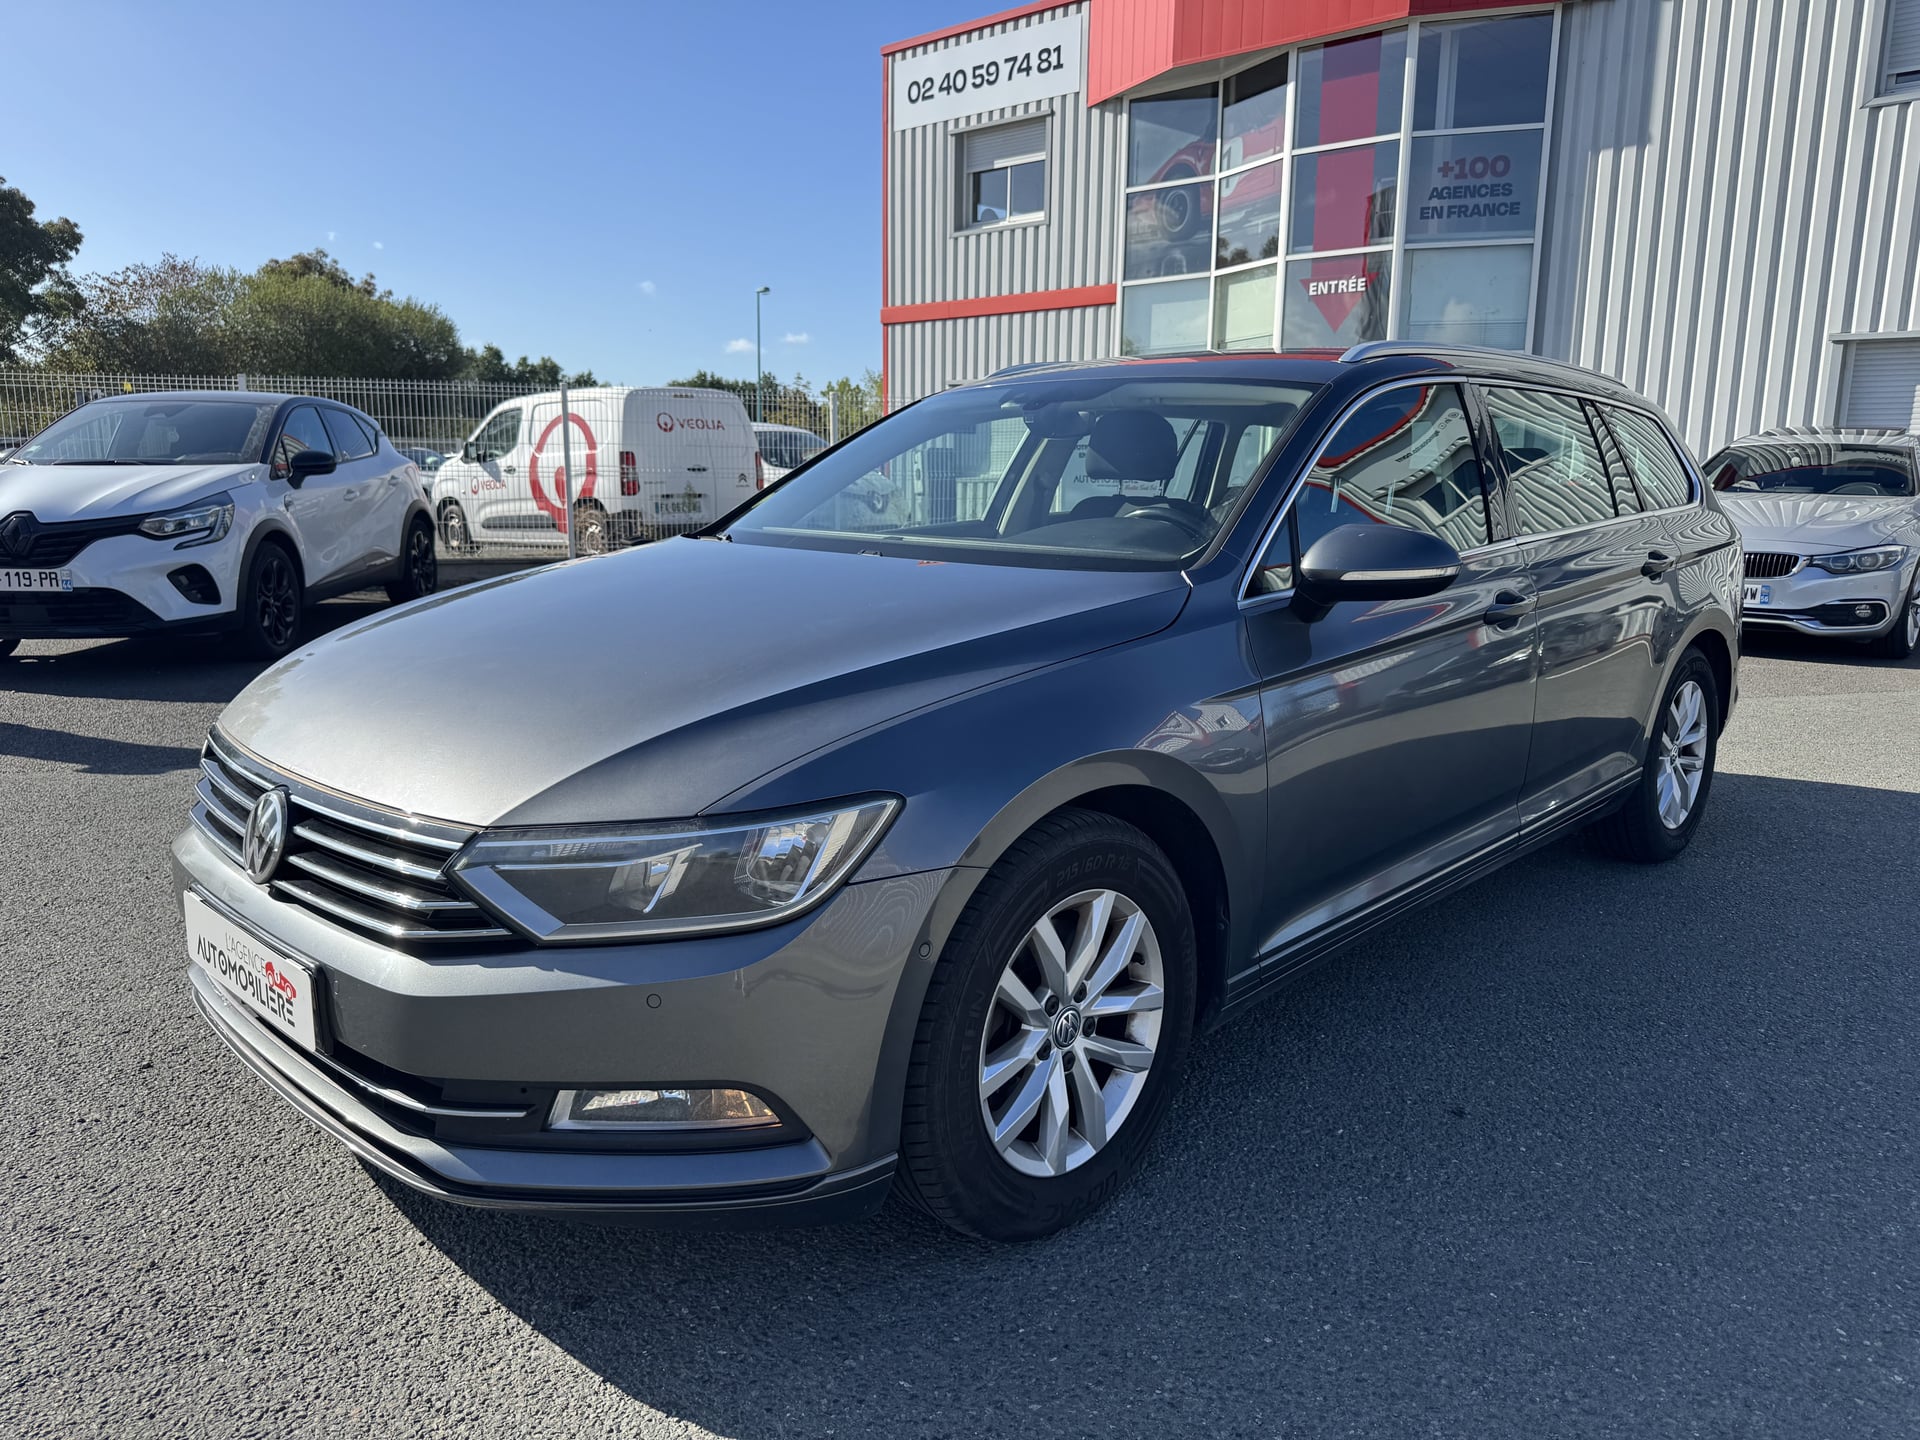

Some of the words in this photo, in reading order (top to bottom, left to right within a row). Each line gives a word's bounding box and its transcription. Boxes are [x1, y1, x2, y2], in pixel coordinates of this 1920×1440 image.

[907, 80, 935, 104] 02
[938, 72, 967, 96] 40
[971, 61, 999, 89] 59
[1004, 52, 1032, 82] 74
[1037, 44, 1064, 74] 81
[1437, 154, 1511, 180] +100
[1428, 182, 1513, 200] AGENCES
[1419, 205, 1444, 220] EN
[1446, 201, 1521, 219] FRANCE
[1308, 275, 1367, 296] ENTRÉE
[676, 418, 726, 431] VEOLIA
[480, 479, 507, 490] VEOLIA
[225, 932, 268, 978] L'AGENCE
[197, 933, 297, 1028] AUTOMOBILIERE
